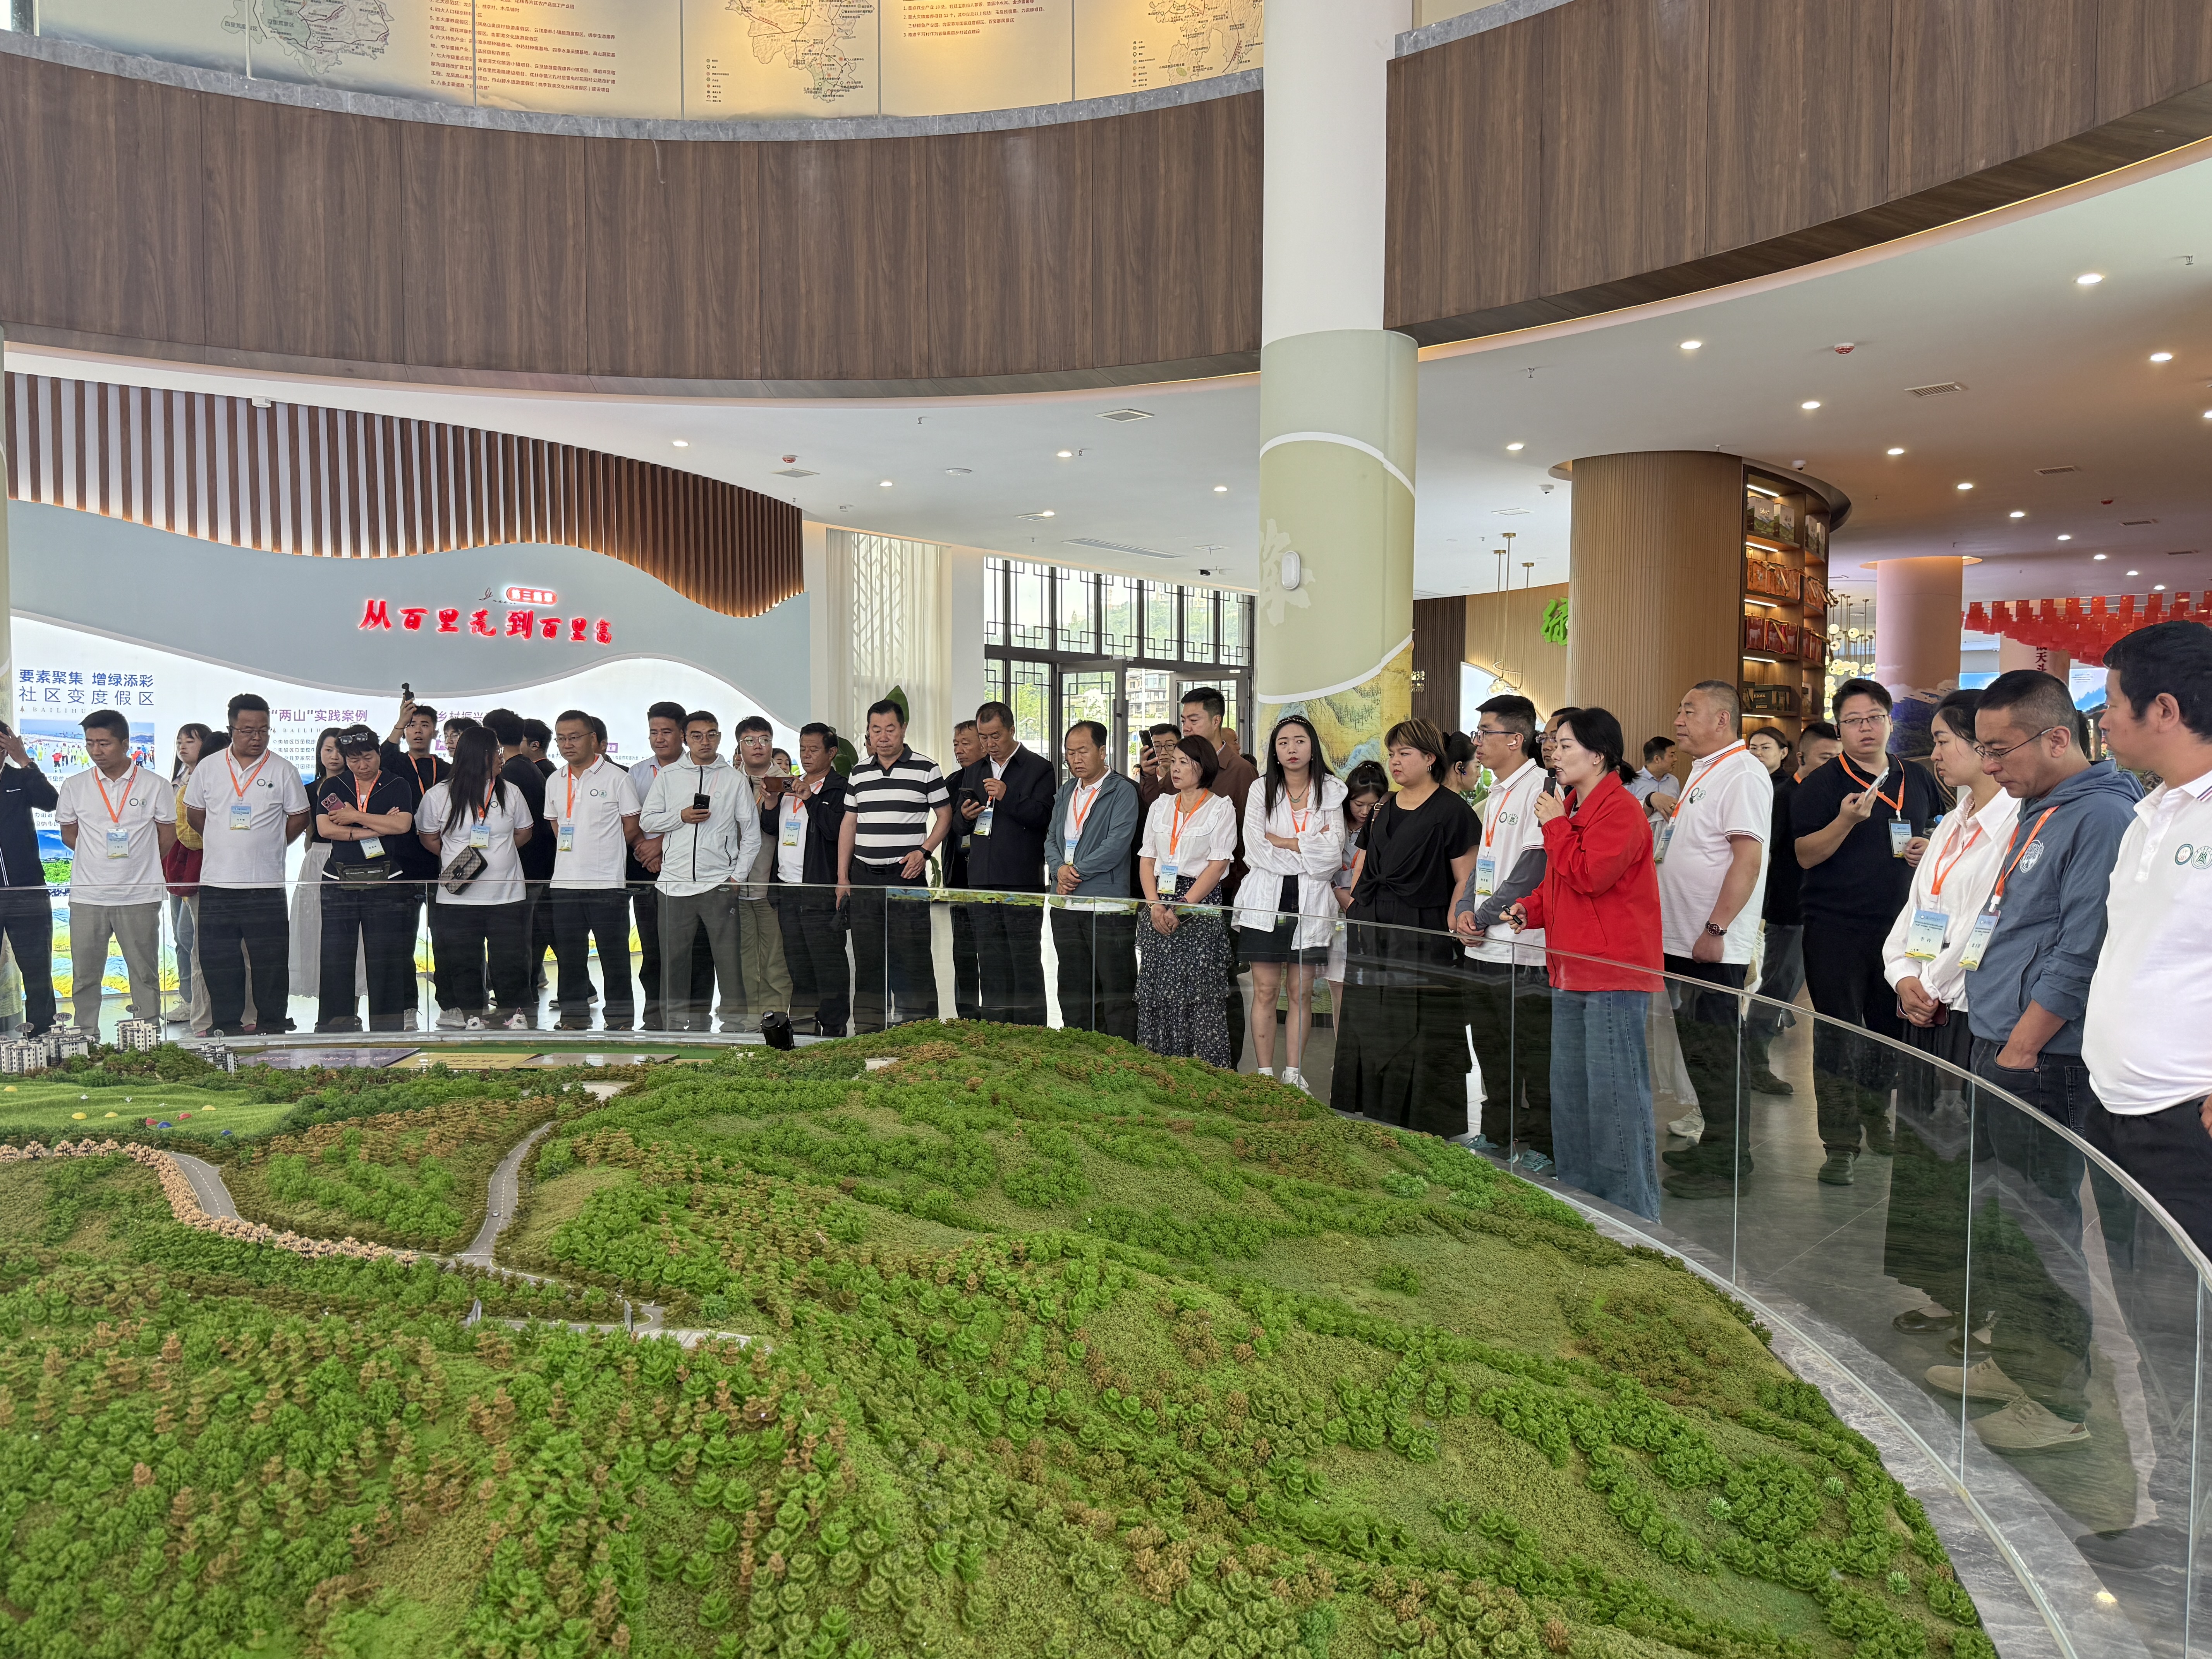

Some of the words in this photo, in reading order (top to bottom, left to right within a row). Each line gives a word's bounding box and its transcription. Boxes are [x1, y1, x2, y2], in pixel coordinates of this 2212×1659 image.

[359, 599, 613, 645] 从百里荒到百里富
[19, 669, 83, 685] 要素聚集
[92, 672, 154, 688] 增绿添彩
[19, 686, 154, 706] 社区变度假区
